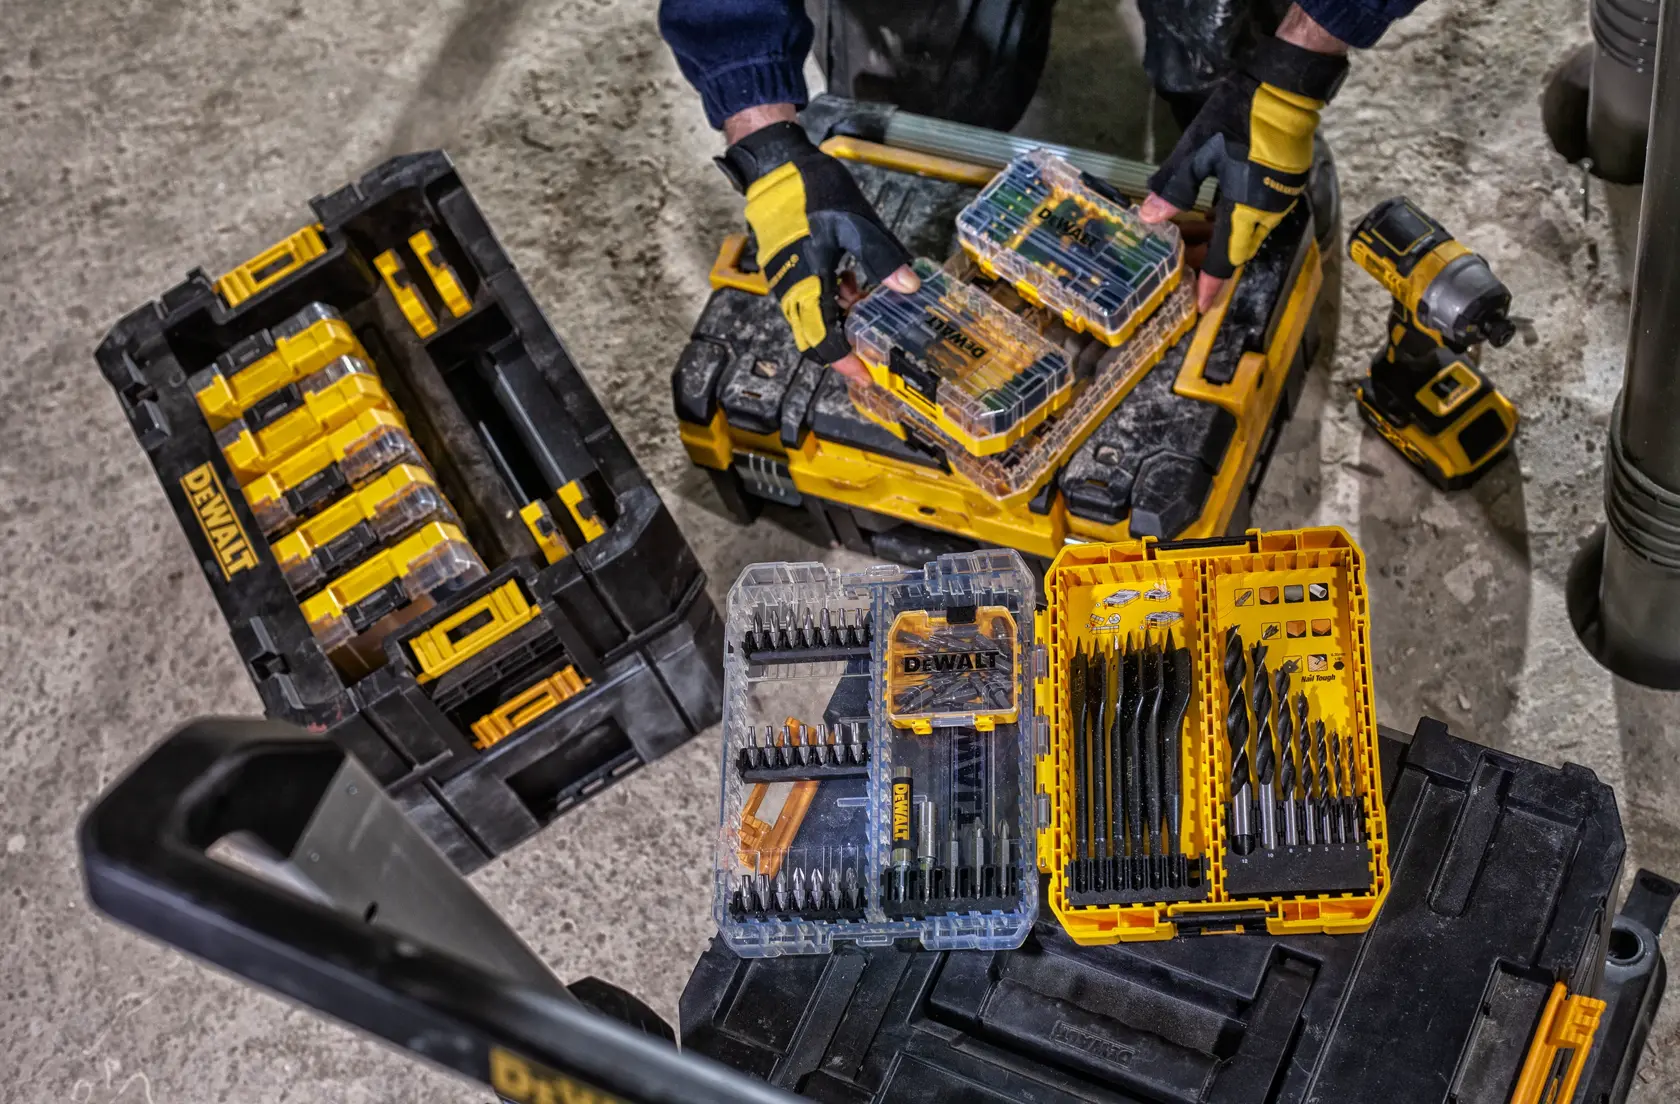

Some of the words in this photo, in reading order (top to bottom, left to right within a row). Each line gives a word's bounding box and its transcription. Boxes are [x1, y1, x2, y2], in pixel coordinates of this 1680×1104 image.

[183, 464, 255, 575] DEWALT
[904, 651, 1000, 672] DEWALT
[894, 784, 908, 841] DEWALT
